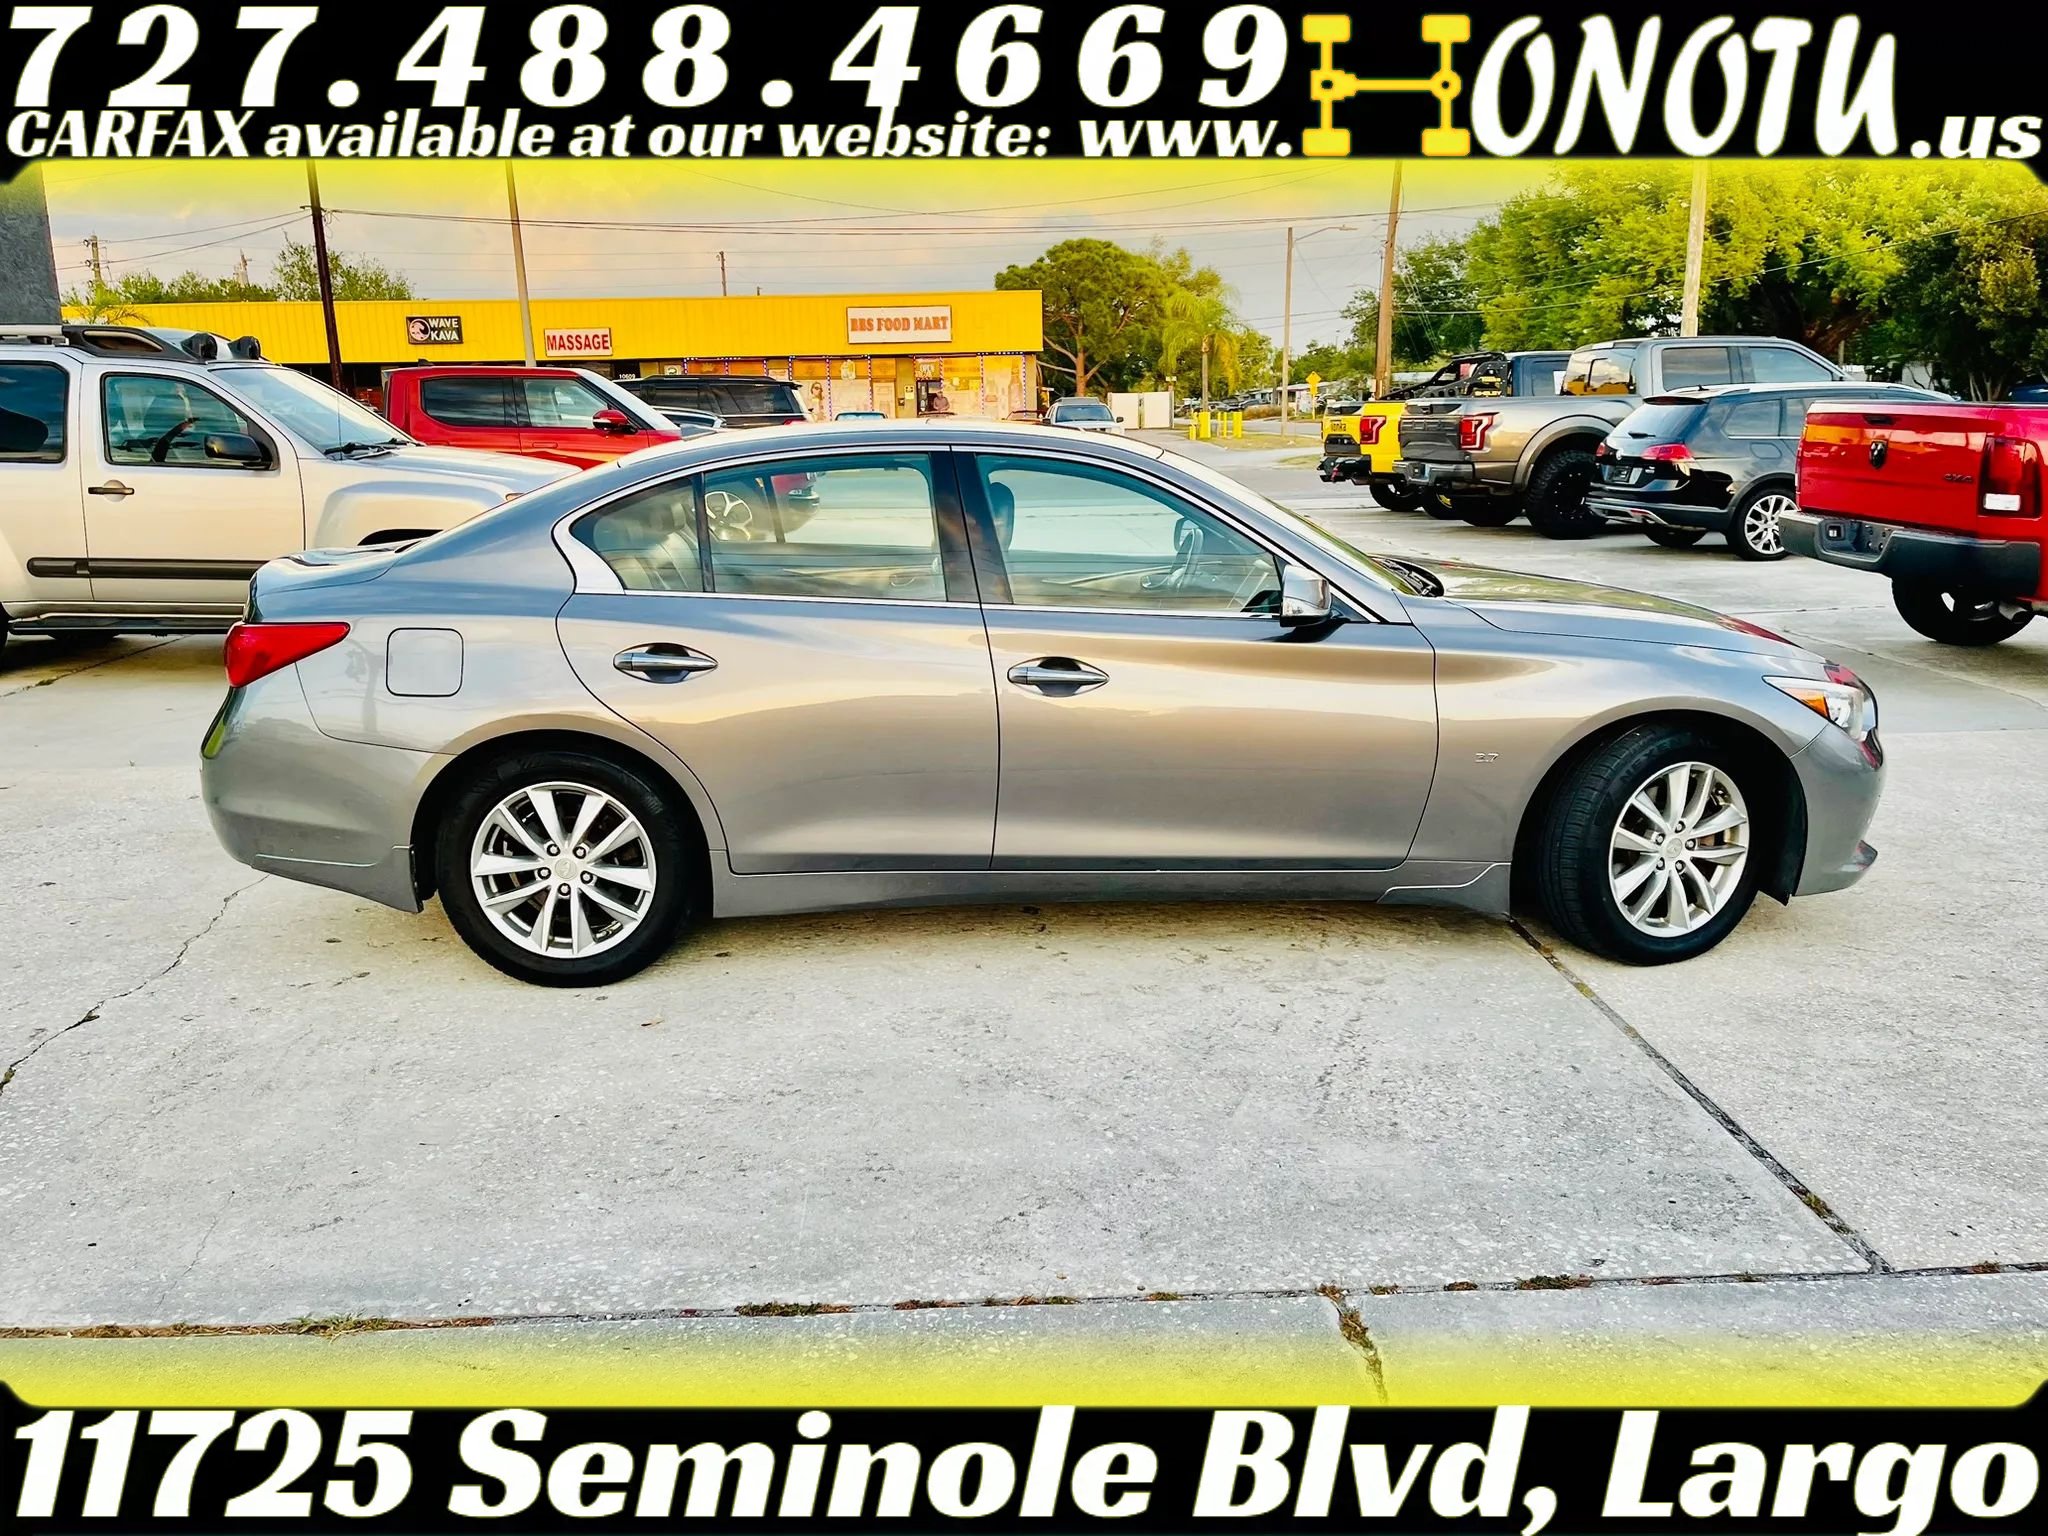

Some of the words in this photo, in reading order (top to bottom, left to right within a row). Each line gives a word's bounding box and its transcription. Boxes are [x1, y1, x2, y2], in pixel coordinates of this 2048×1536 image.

[428, 318, 459, 328] WAVE
[876, 316, 910, 332] FOOD
[914, 315, 948, 331] MART
[430, 330, 459, 341] KAVA
[546, 334, 609, 351] MASSAGE
[1475, 751, 1500, 763] 3.7
